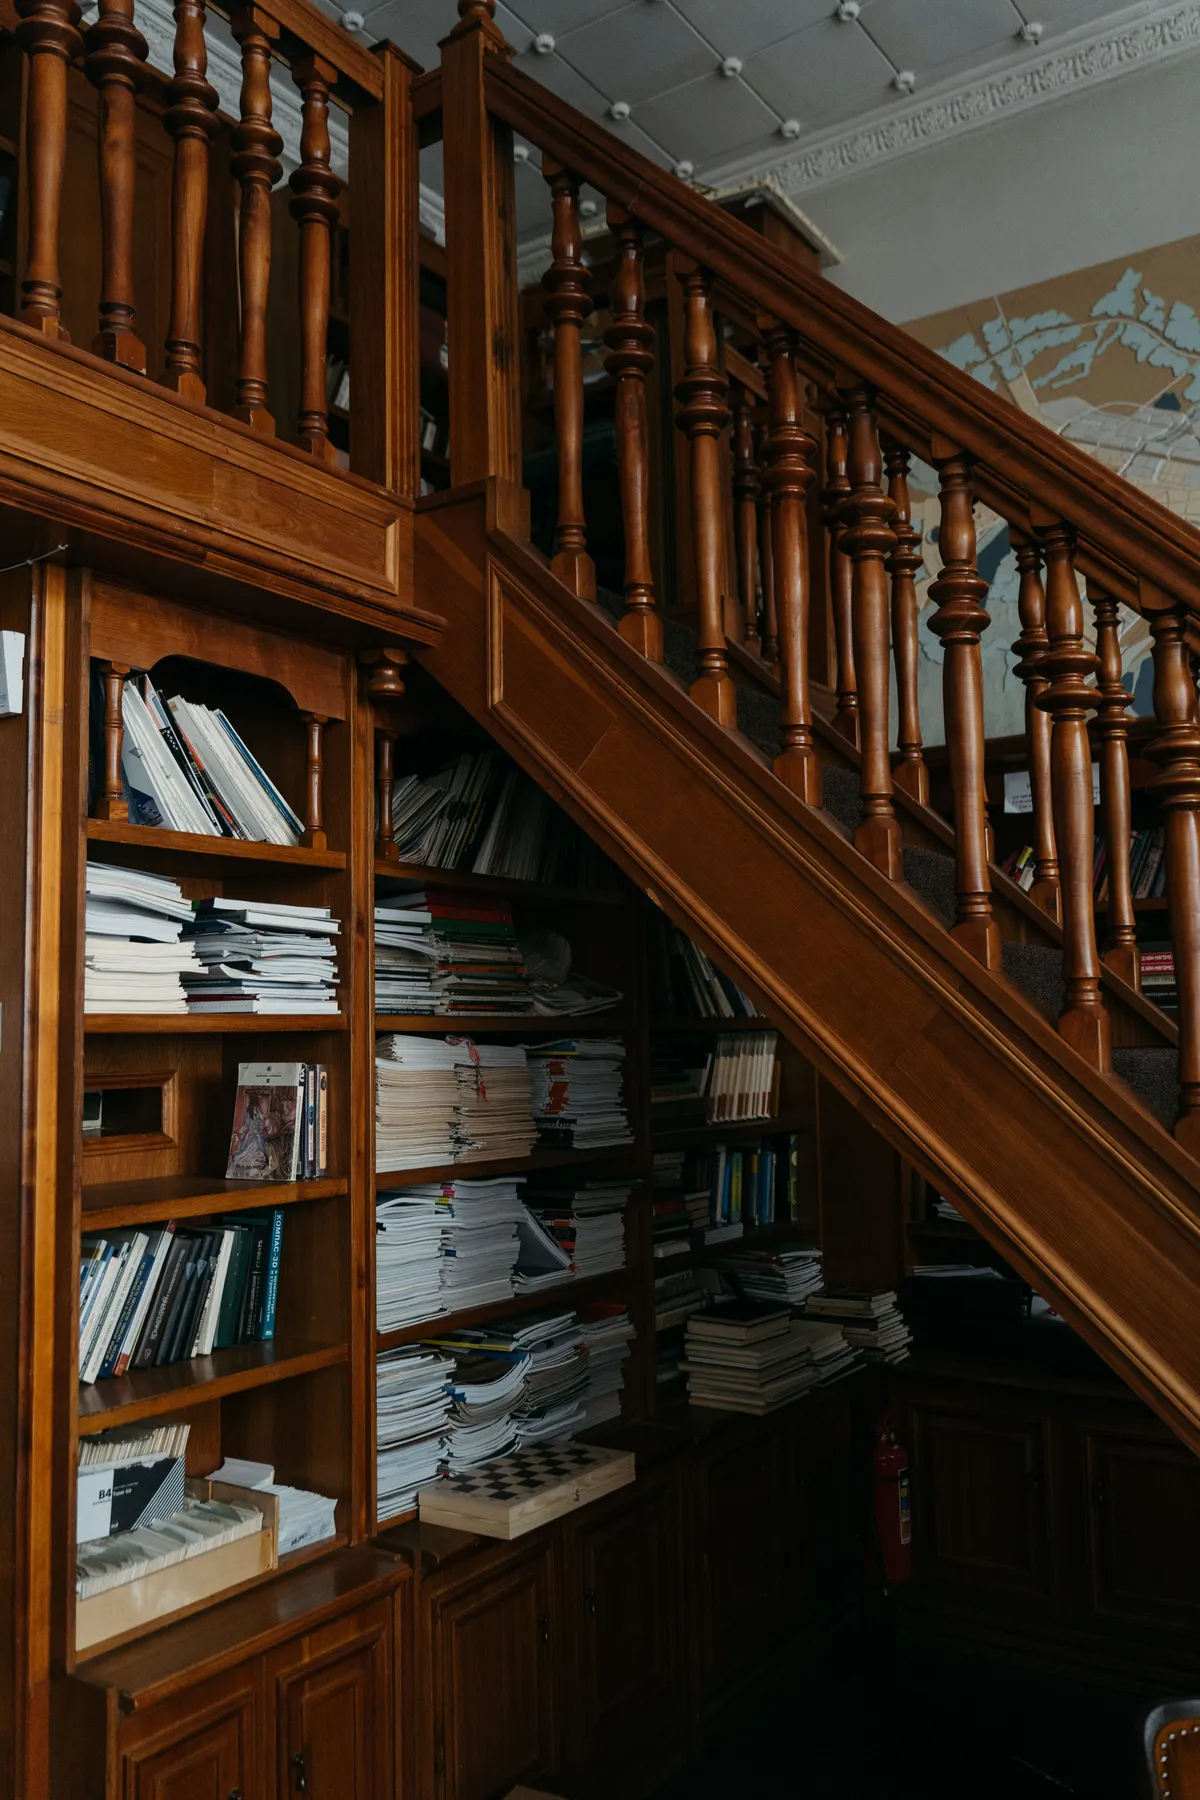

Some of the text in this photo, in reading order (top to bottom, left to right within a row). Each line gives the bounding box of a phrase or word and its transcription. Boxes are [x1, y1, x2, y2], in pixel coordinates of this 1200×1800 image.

[272, 1214, 282, 1268] КОМПАС-3D
[150, 1295, 169, 1340] КОММЕНТАРИЙ
[99, 1488, 111, 1500] B4
